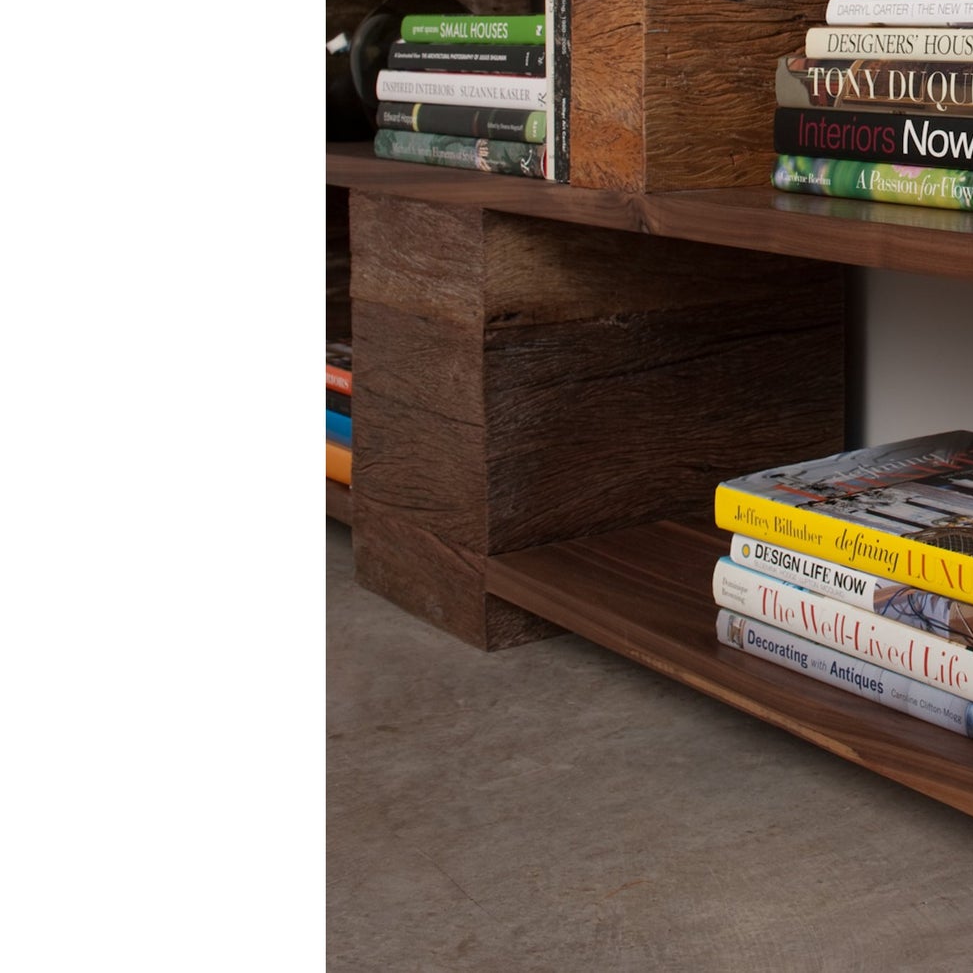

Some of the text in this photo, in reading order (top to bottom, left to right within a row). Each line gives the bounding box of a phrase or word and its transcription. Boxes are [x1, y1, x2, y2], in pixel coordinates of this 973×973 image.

[837, 3, 871, 16] DARRYL
[873, 3, 910, 16] CARTER
[917, 3, 936, 16] THE
[937, 2, 960, 15] NEW
[440, 22, 469, 39] SMALL
[470, 22, 509, 39] HOUSES
[382, 80, 531, 102] INSPIRED INTERIORS SUZANNE KASLER
[808, 67, 881, 100] TONY
[799, 113, 896, 154] Interiors
[856, 169, 866, 190] A
[869, 170, 917, 196] Passion
[918, 174, 939, 201] for
[734, 505, 770, 536] Jeffrey
[774, 516, 823, 545] Bilhuber
[834, 528, 900, 574] defining
[754, 543, 801, 574] DESIGN
[802, 560, 832, 585] LIFE
[833, 572, 867, 596] NOW
[758, 585, 795, 626] The
[800, 601, 914, 672] Well-Lived
[924, 646, 968, 691] Life
[747, 629, 809, 669] Decorating
[810, 658, 827, 672] with
[829, 661, 884, 694] Antiques
